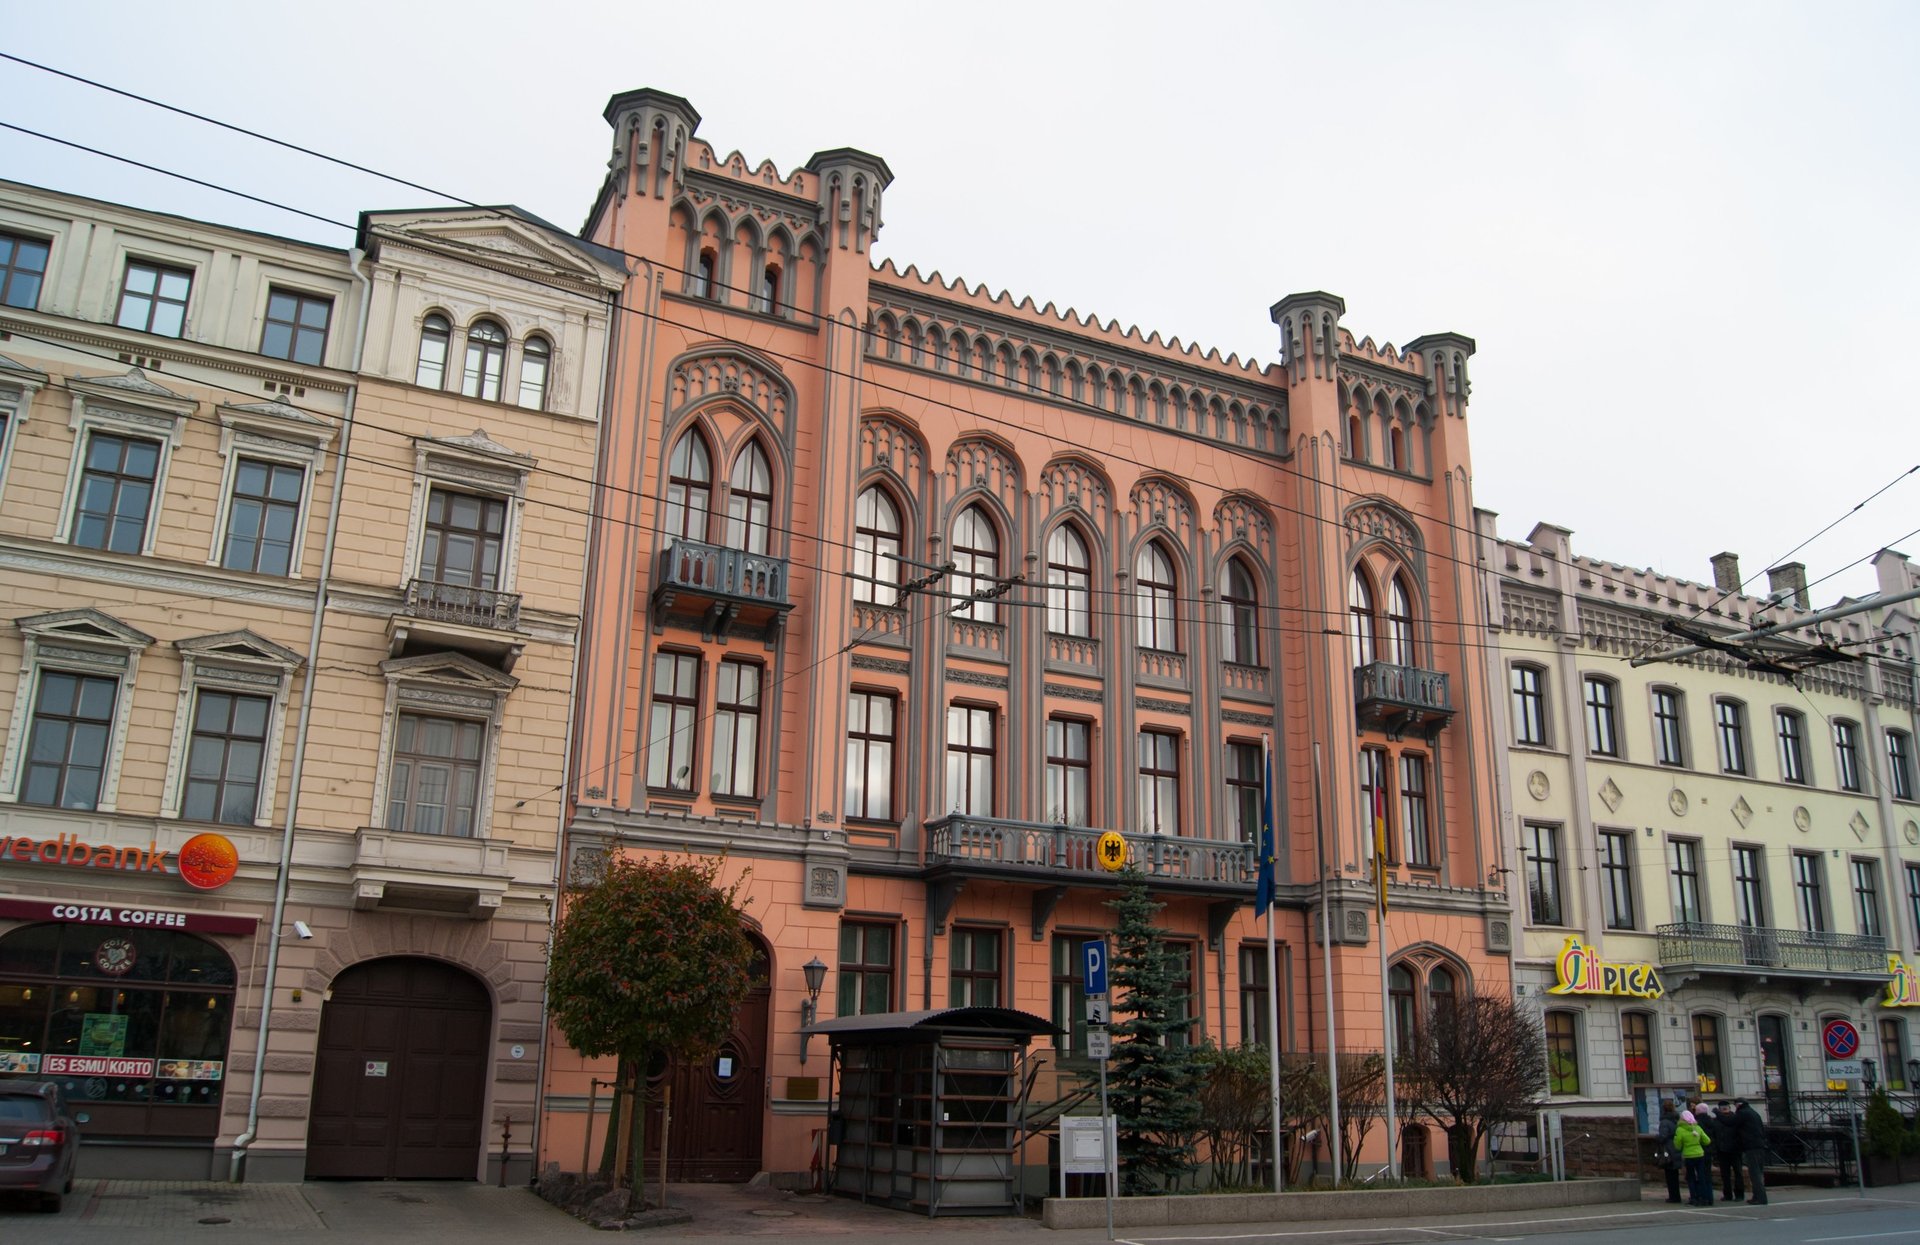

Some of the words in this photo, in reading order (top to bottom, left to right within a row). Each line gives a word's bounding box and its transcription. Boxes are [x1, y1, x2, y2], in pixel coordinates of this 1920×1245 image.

[52, 905, 112, 921] COSTA
[118, 910, 186, 927] COFFEE
[103, 939, 131, 950] COSTA
[1088, 948, 1100, 988] P
[1603, 966, 1662, 993] PICA
[50, 1058, 67, 1071] ES
[69, 1058, 106, 1074] ESMU
[108, 1062, 152, 1075] KORTO
